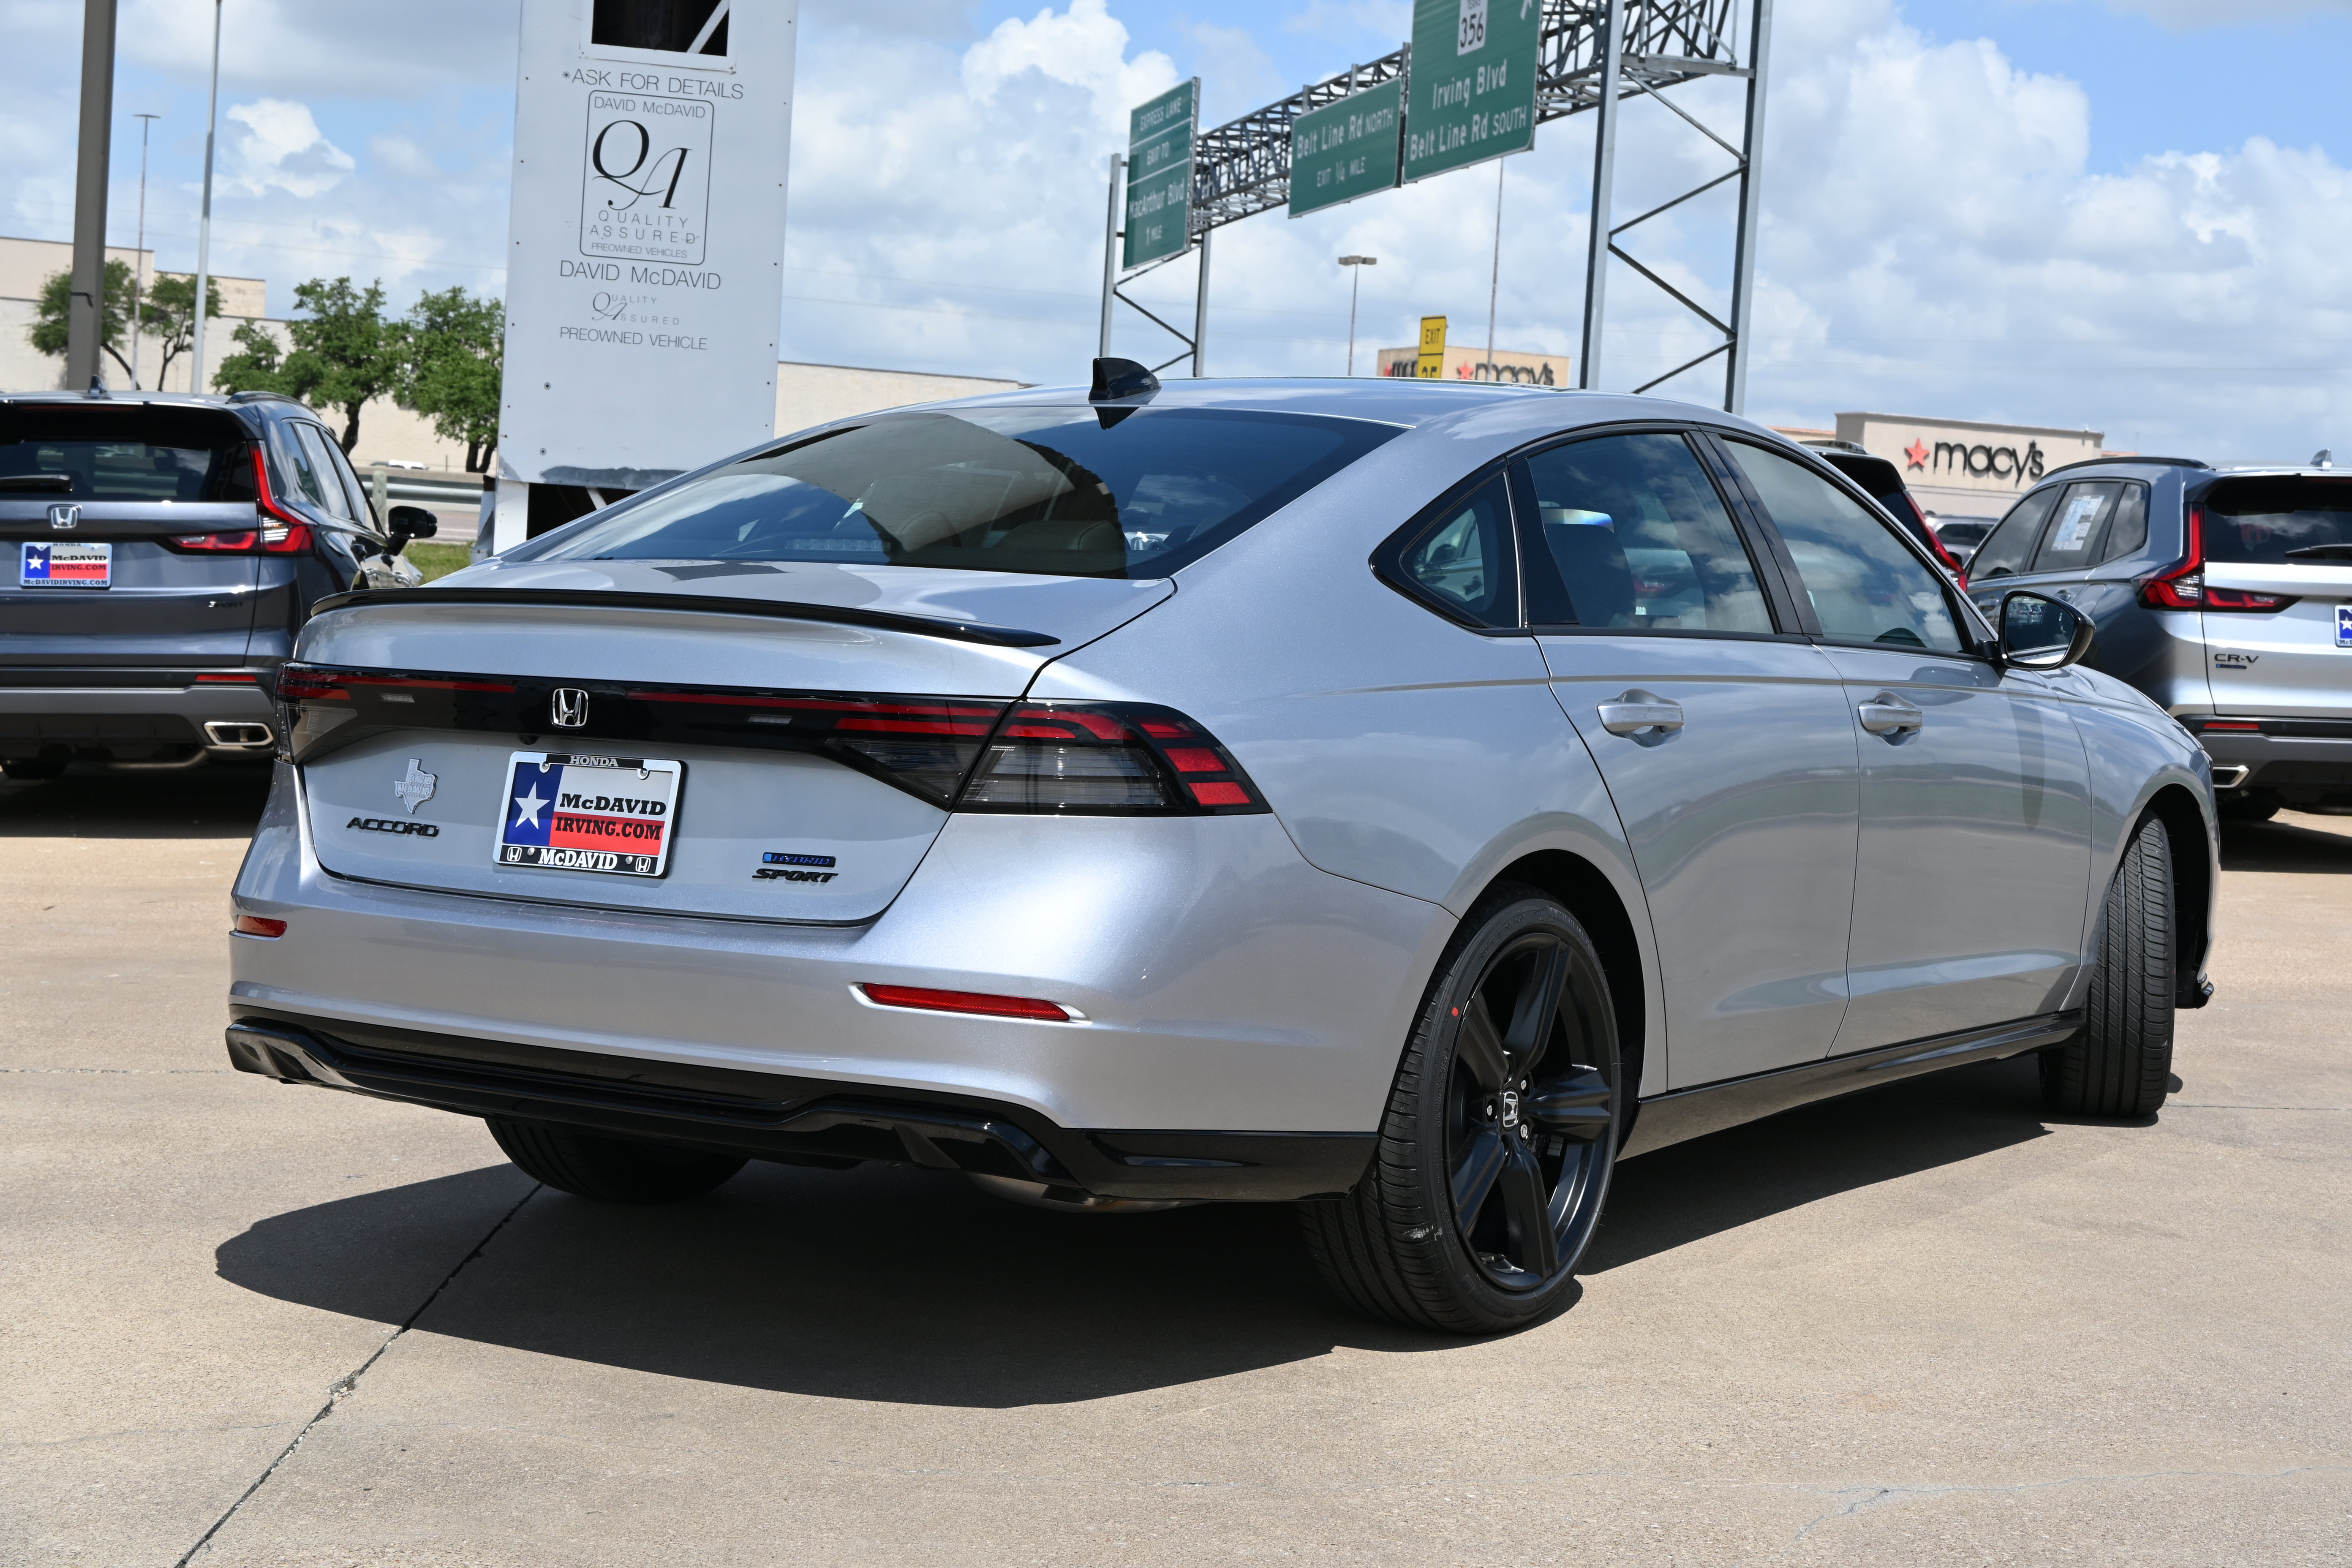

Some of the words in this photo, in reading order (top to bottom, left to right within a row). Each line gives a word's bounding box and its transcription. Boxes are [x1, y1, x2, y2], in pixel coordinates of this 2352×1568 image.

[1460, 11, 1484, 48] 356
[621, 73, 659, 90] FOR
[668, 77, 743, 99] DETAILS
[1433, 77, 1470, 109] Irving
[1476, 58, 1507, 95] Blvd
[594, 96, 635, 111] DAVID
[643, 101, 705, 118] McDAVID
[1140, 106, 1164, 131] EXPRESS
[1166, 97, 1181, 118] LANE
[1297, 130, 1317, 159] Belt
[1322, 125, 1344, 150] Line
[1349, 113, 1363, 140] Rd
[1365, 106, 1393, 135] NORTH
[1410, 130, 1435, 161] Belt
[1439, 124, 1466, 152] Line
[1472, 112, 1489, 142] Rd
[1493, 106, 1527, 136] SOUTH
[1147, 145, 1160, 166] EXIT
[1162, 142, 1170, 159] TO
[1317, 168, 1331, 187] EXIT
[1350, 156, 1366, 176] MILE
[1128, 189, 1166, 220] MacArthur
[1168, 178, 1184, 205] Blvd
[598, 210, 688, 228] QUALITY
[590, 225, 695, 244] ASSURED
[1151, 225, 1162, 240] MILE
[591, 242, 642, 254] PREOWNED
[645, 247, 687, 258] VEHICLES
[560, 260, 620, 281] DAVID
[631, 266, 721, 290] McDAVID
[560, 327, 642, 345] PREOWNED
[649, 334, 708, 351] VEHICLE
[1425, 328, 1440, 344] EXIT
[2214, 654, 2259, 663] CR-V
[569, 756, 619, 767] HONDA
[410, 774, 433, 784] DAVID
[559, 793, 667, 816] McDAVID
[346, 817, 440, 837] ACCORD
[555, 817, 662, 840] IRVING.COM
[538, 849, 618, 869] McDAVID
[772, 855, 830, 865] HYBRID
[751, 868, 839, 883] SPORT
